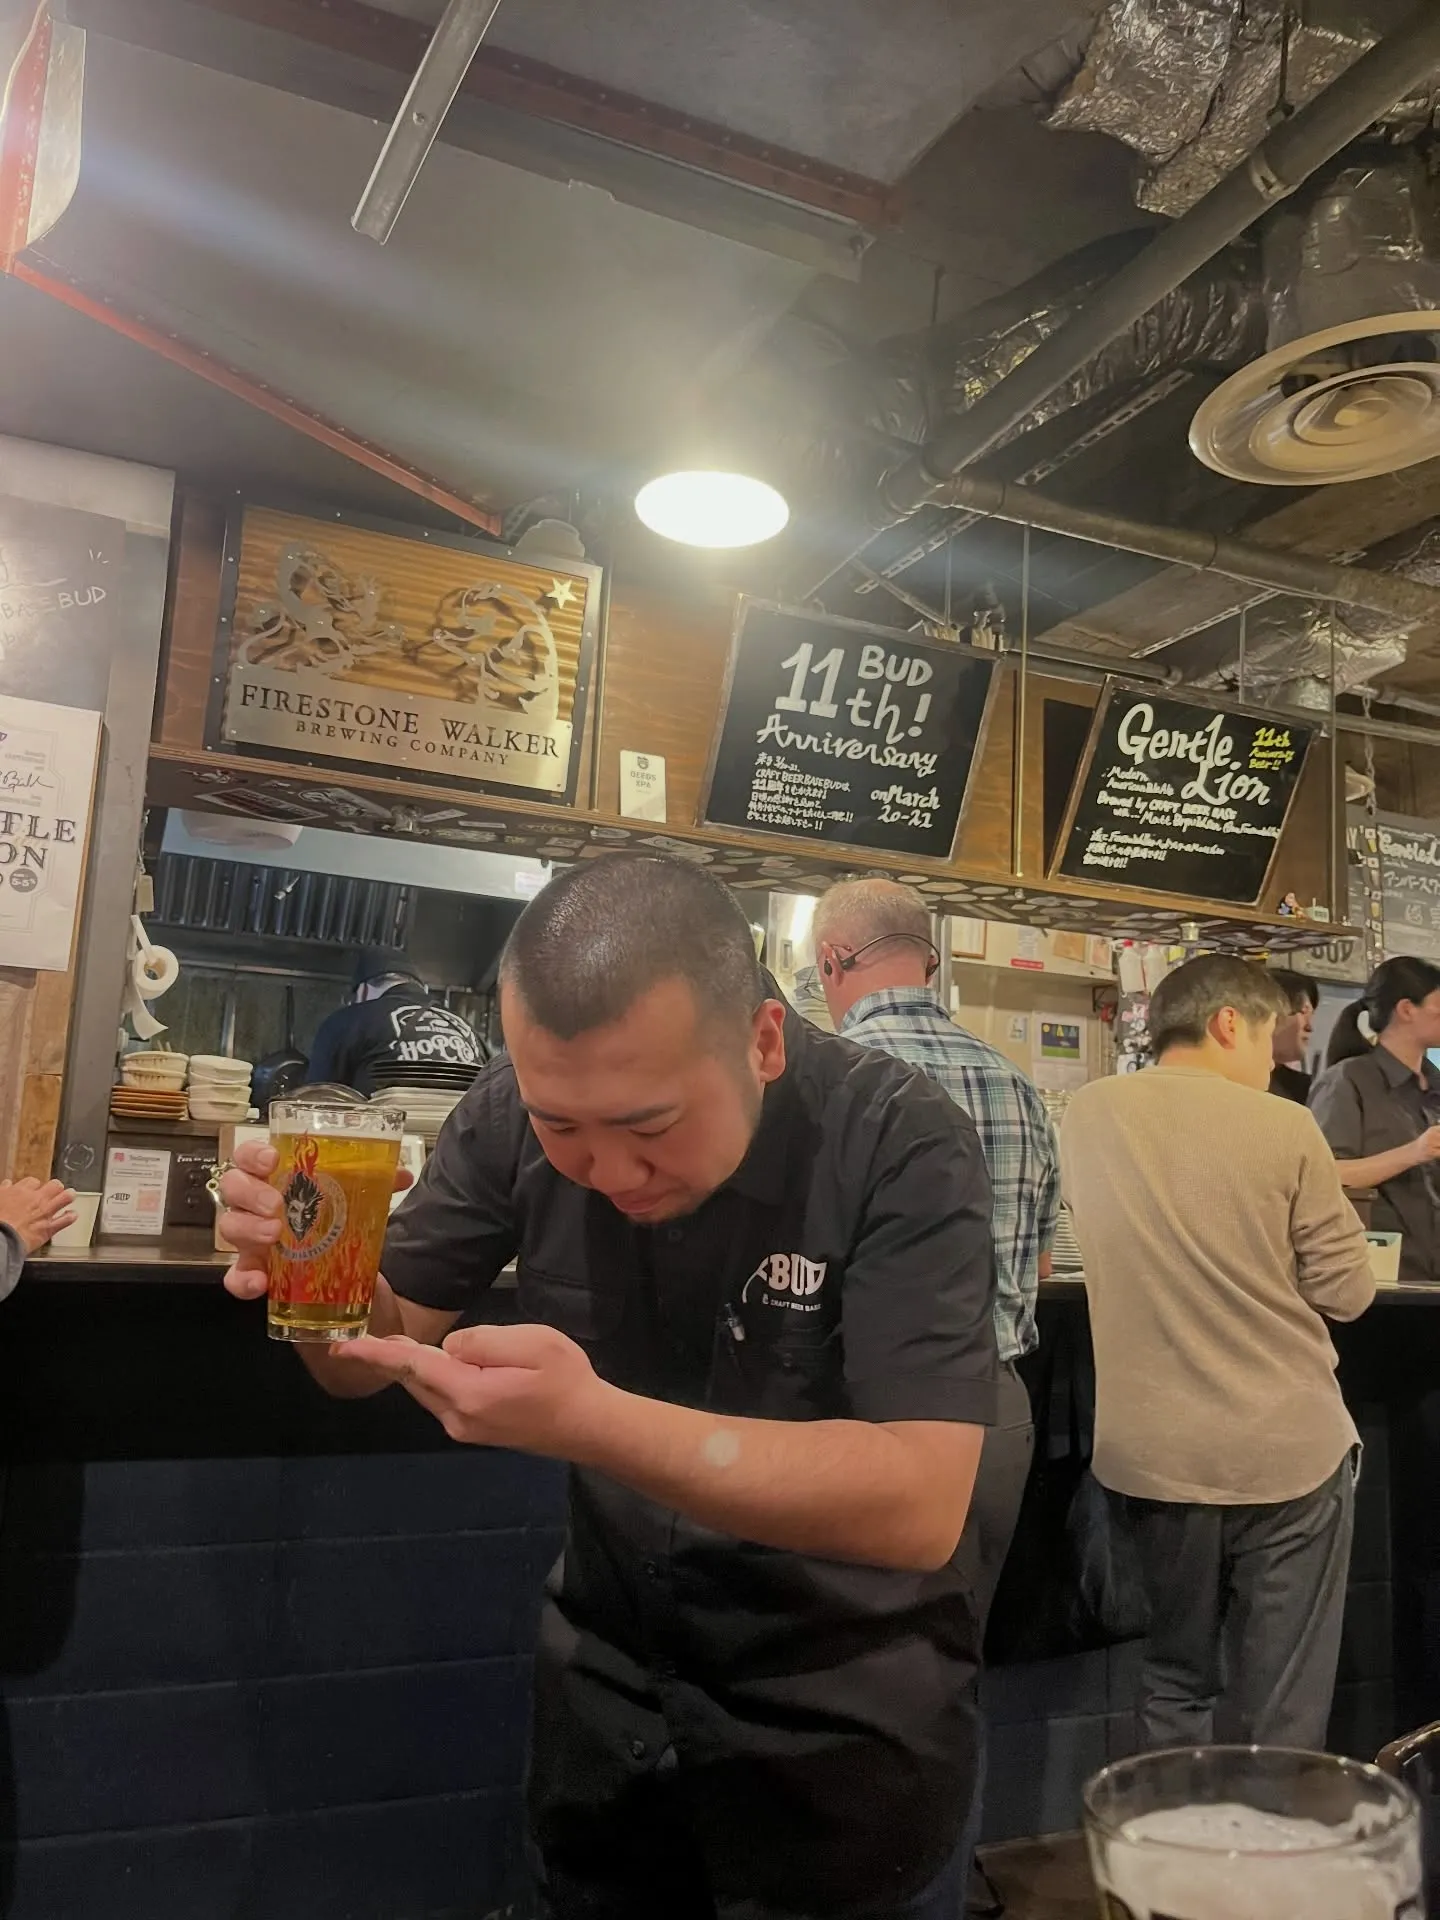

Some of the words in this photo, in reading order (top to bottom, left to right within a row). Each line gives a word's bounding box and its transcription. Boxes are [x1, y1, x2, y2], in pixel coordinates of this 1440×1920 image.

[58, 585, 107, 609] BUD
[775, 642, 845, 718] 11
[857, 645, 934, 687] BUD
[239, 683, 420, 735] FIRESTONE
[440, 717, 560, 759] WALKER
[295, 720, 398, 748] BREWING
[409, 738, 509, 765] COMPANY
[1117, 703, 1234, 769] Gentle
[1252, 727, 1292, 748] 11th
[756, 713, 938, 778] Anniversary
[755, 768, 781, 780] CRAFT
[781, 771, 804, 785] BEER
[882, 784, 942, 810] March
[1180, 760, 1271, 806] Lion
[768, 1253, 828, 1296] BUD
